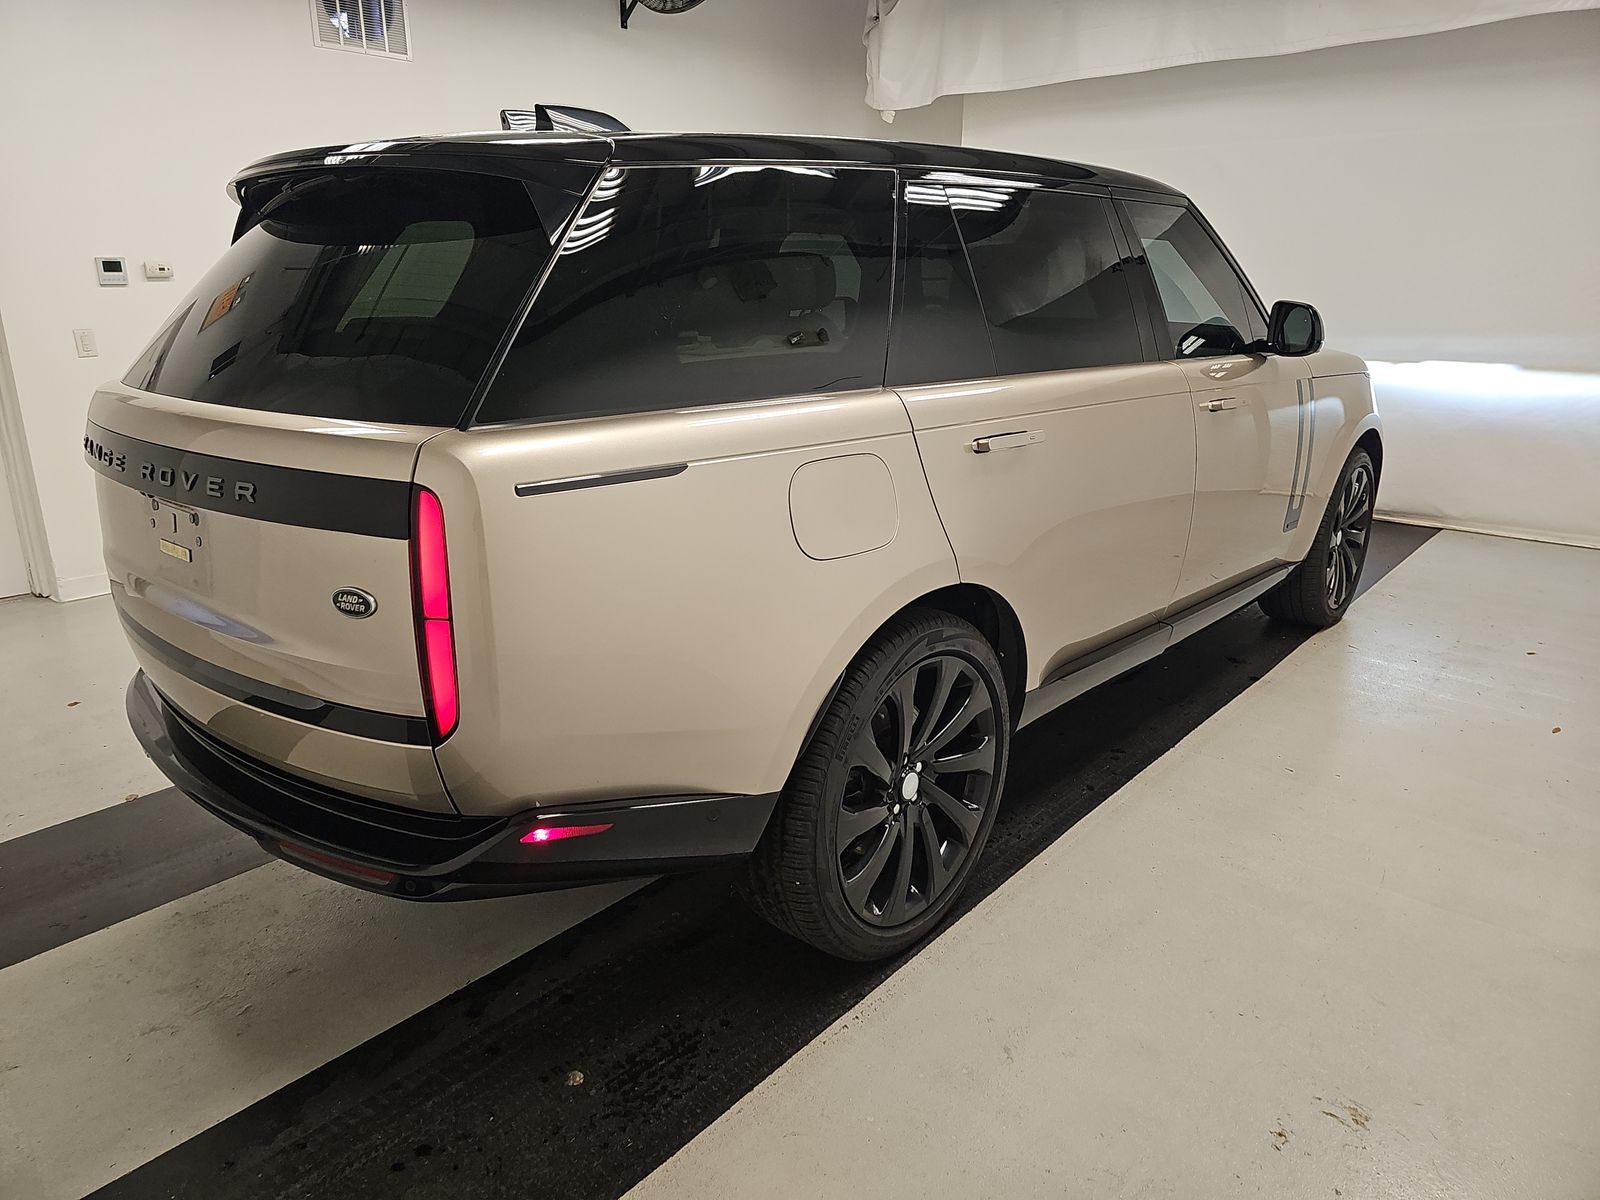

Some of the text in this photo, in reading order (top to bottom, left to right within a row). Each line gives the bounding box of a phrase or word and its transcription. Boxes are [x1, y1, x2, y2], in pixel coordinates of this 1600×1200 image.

[140, 462, 258, 504] ROVER
[338, 593, 359, 604] LAND
[340, 602, 366, 613] ROVER
